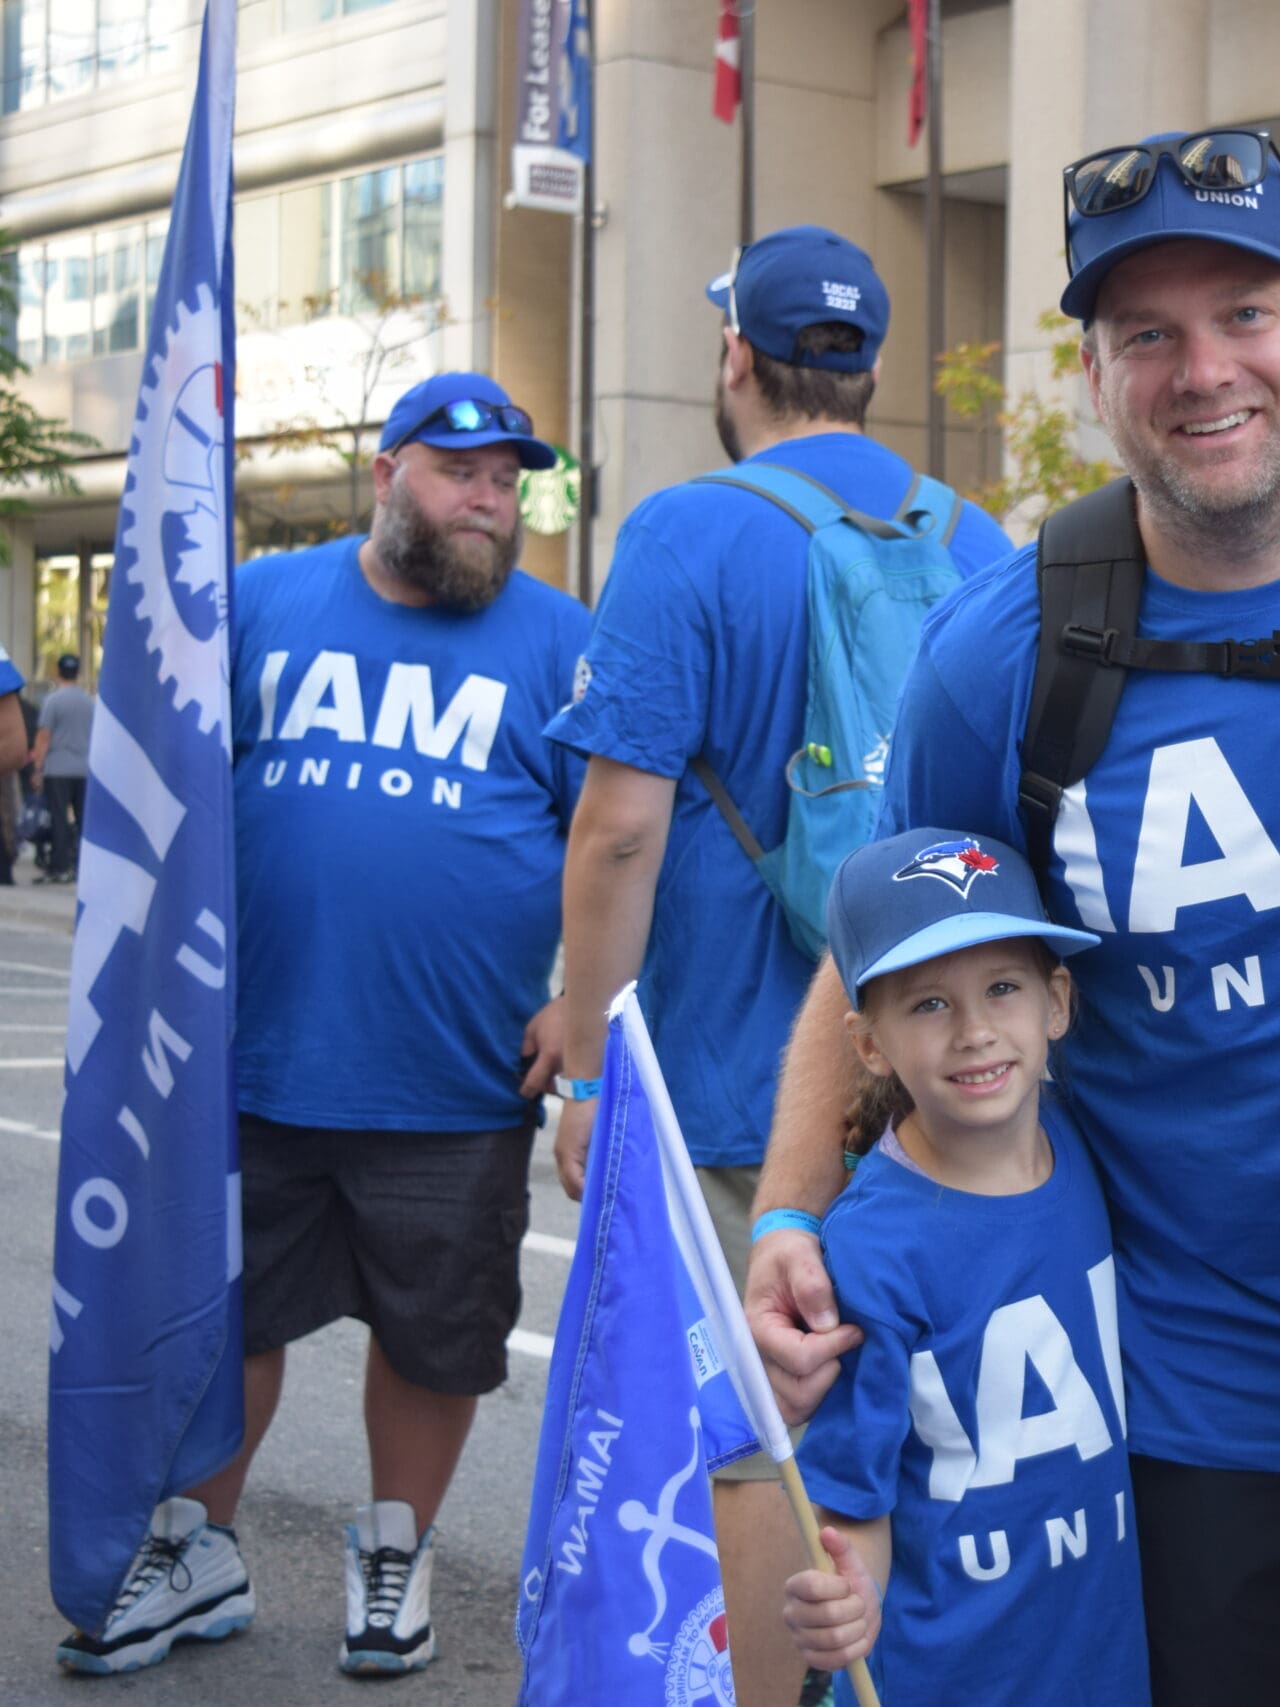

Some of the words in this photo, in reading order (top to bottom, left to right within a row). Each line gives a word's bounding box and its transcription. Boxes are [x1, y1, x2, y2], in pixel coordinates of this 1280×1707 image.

[523, 92, 550, 142] For
[1195, 189, 1259, 210] UNION
[822, 280, 861, 300] LOCAL
[257, 649, 508, 773] IAM
[262, 757, 463, 810] UNION
